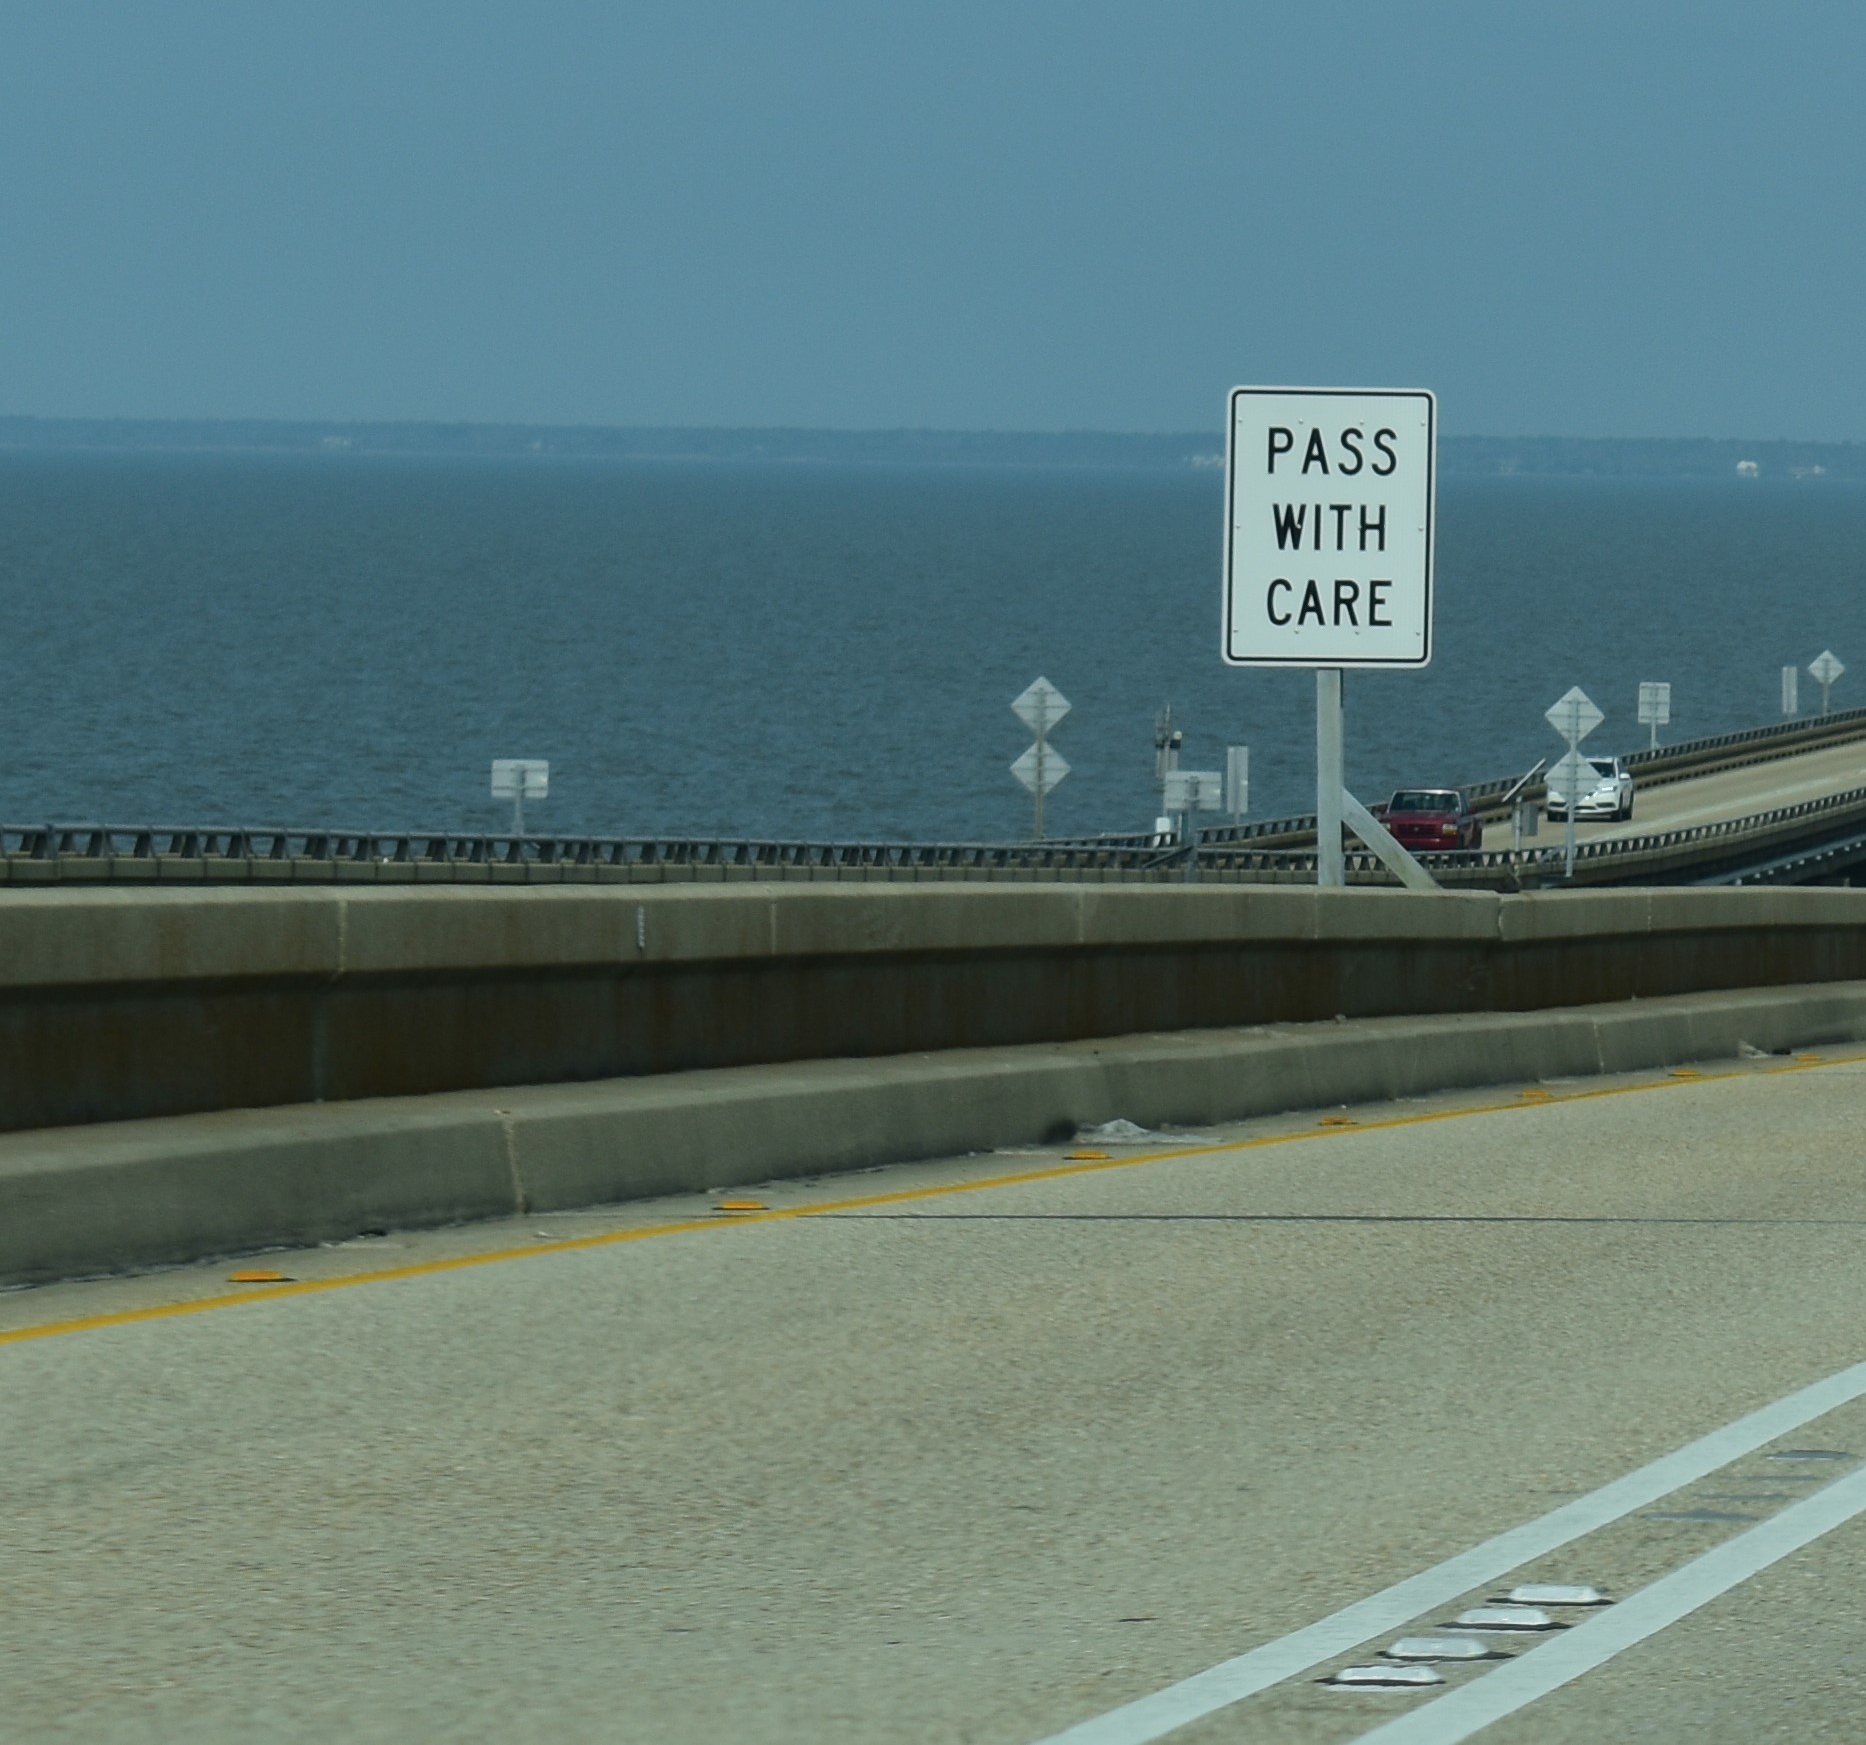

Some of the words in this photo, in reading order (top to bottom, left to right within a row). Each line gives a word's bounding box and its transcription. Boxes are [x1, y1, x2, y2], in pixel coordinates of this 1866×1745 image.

[1267, 427, 1397, 476] PASS
[1272, 504, 1386, 551] WITH
[1267, 578, 1392, 626] CARE
